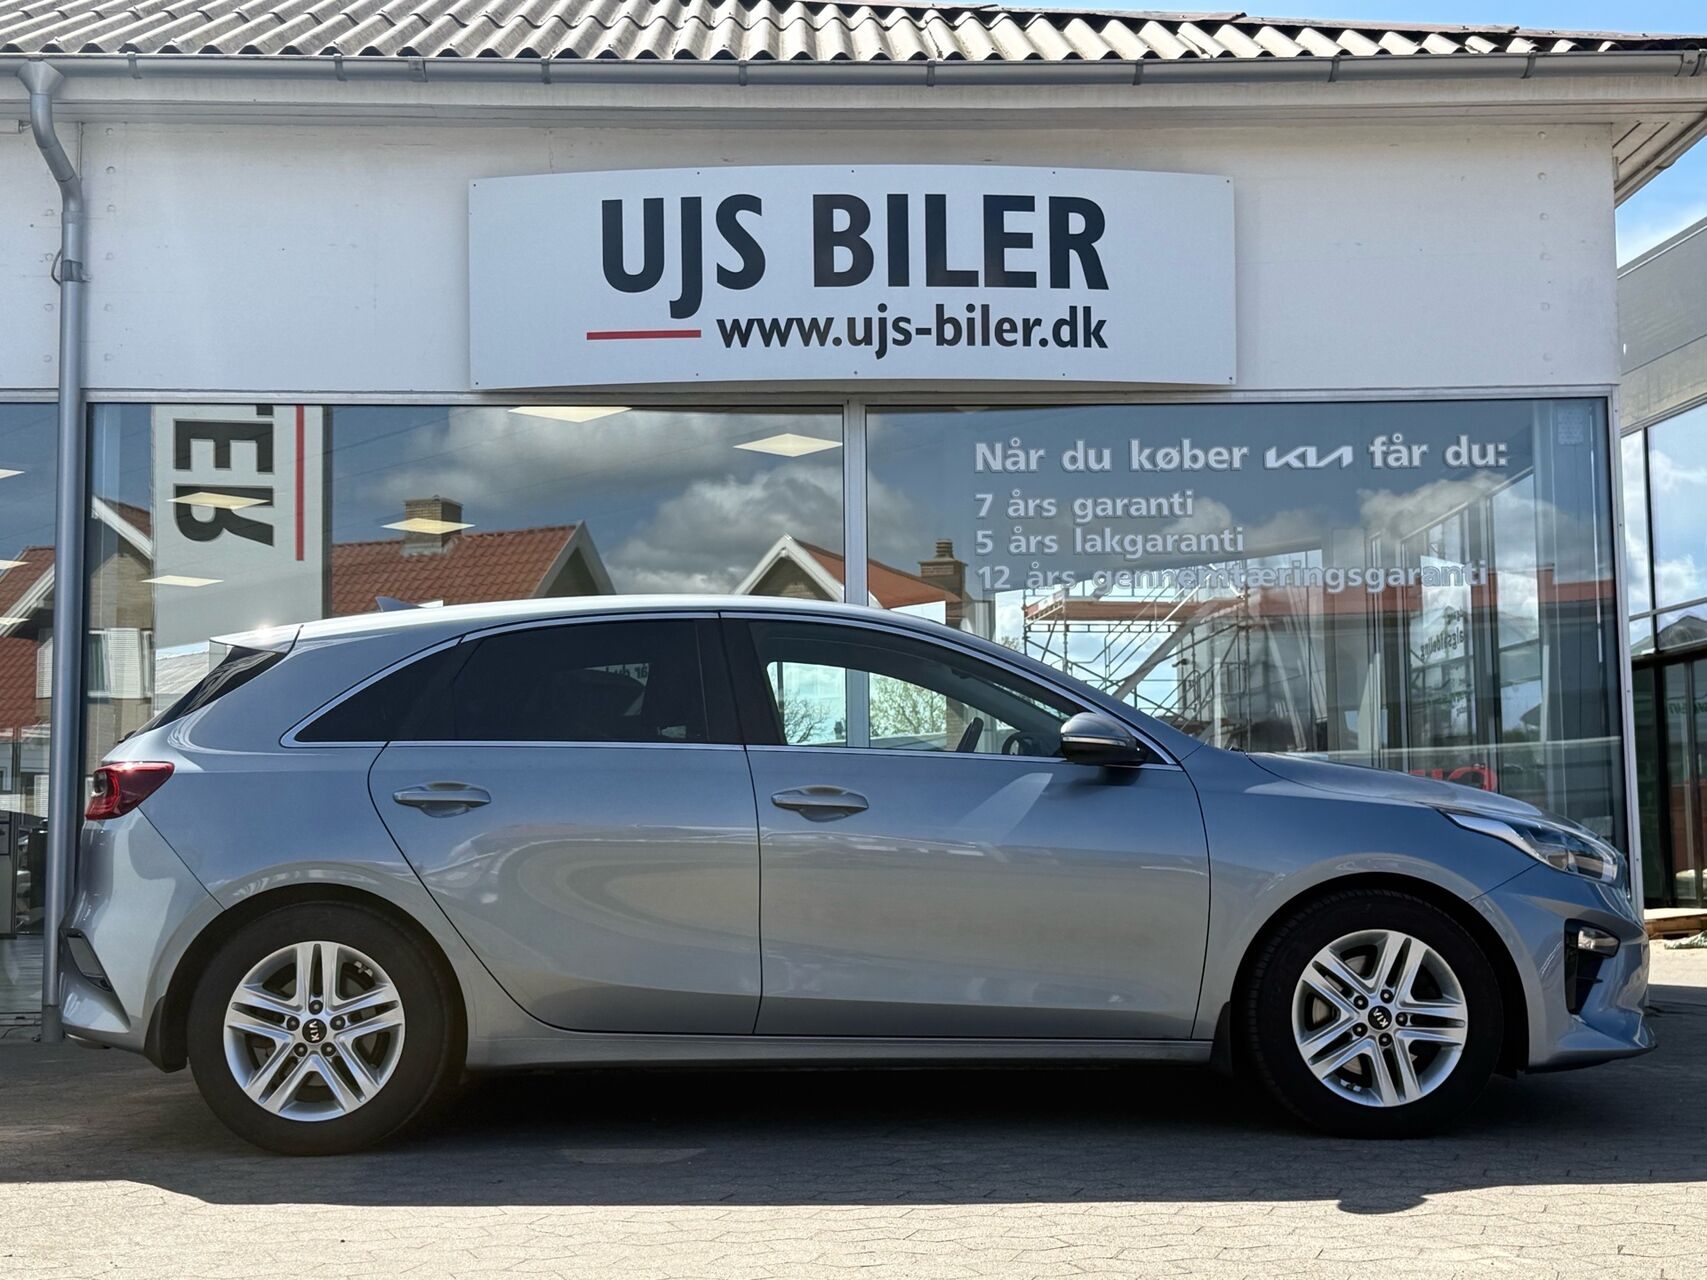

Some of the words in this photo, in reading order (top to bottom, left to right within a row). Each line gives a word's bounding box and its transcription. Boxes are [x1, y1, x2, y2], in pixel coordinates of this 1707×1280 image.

[601, 193, 766, 319] UJS
[812, 193, 1110, 290] BILER
[716, 303, 1108, 359] www.ujs-biler.dk
[974, 437, 1045, 472] Når
[1061, 440, 1113, 472] du
[1128, 438, 1249, 472] køber
[1368, 433, 1428, 468] får
[1445, 435, 1509, 468] du:
[974, 493, 993, 518] 7
[1007, 488, 1058, 518] års
[1073, 489, 1194, 524] garanti
[975, 530, 993, 555] 5
[1008, 526, 1059, 555] års
[1074, 523, 1244, 559] lakgaranti
[976, 566, 1011, 590] 12
[1026, 561, 1076, 591] års
[309, 1020, 320, 1041] KIA
[1374, 1008, 1388, 1027] KIA
